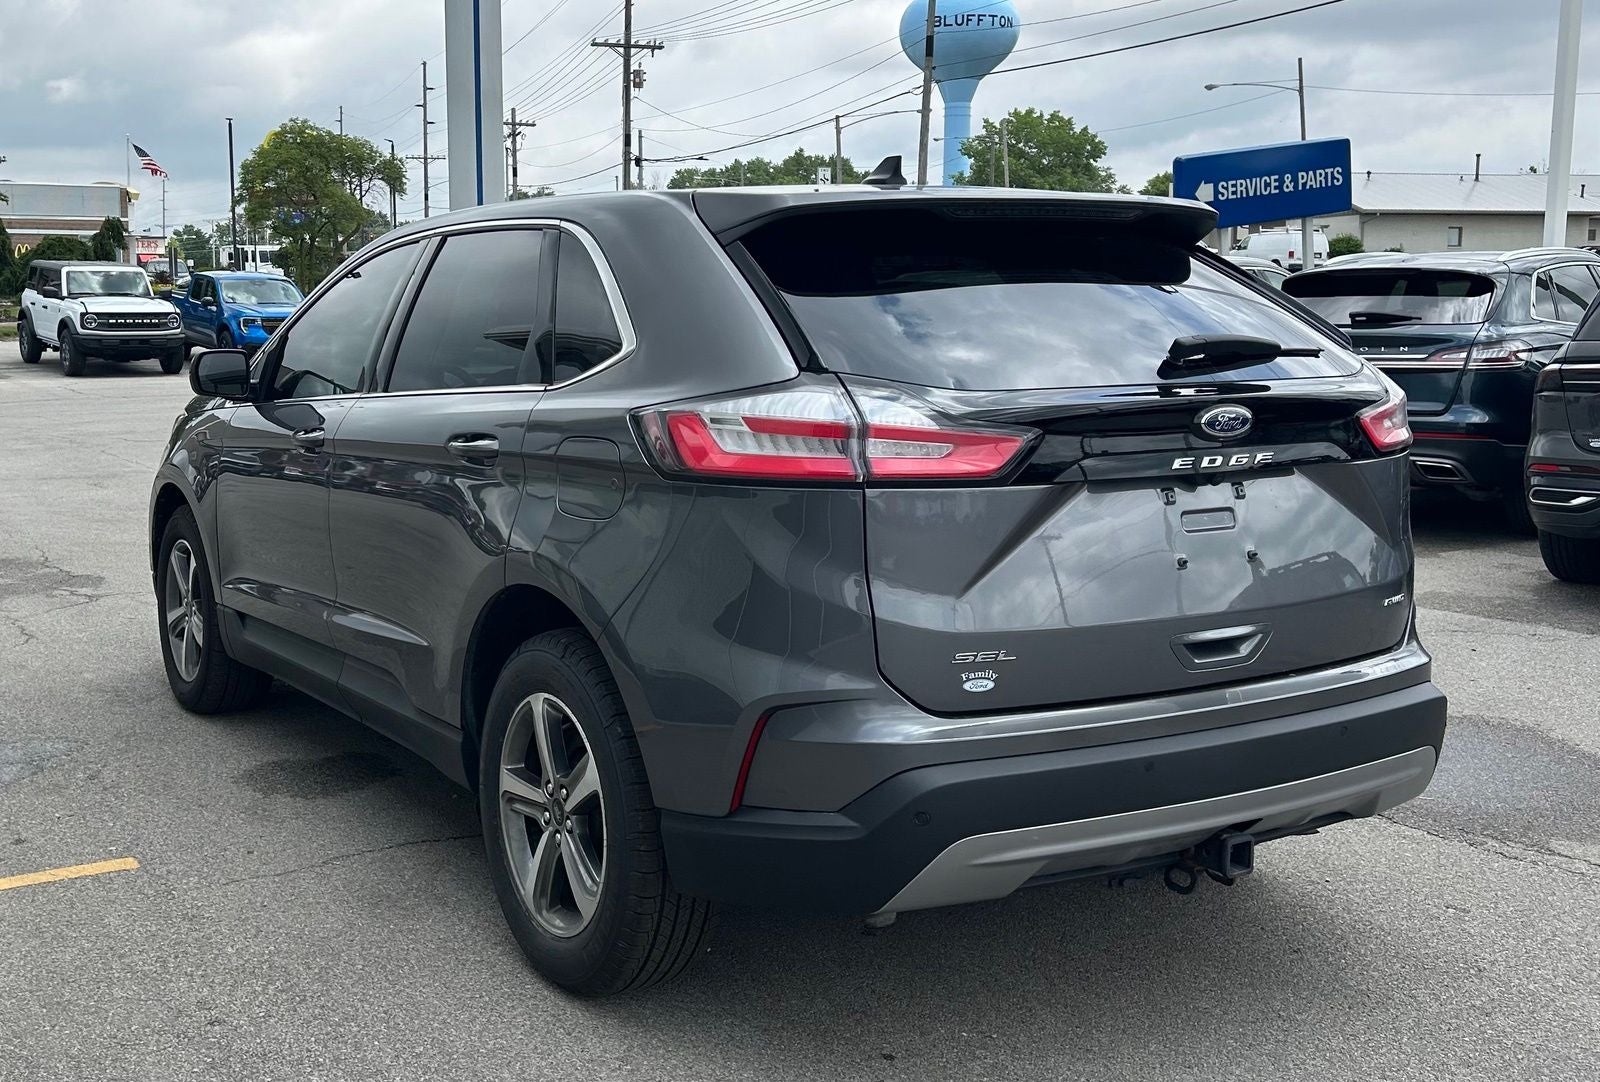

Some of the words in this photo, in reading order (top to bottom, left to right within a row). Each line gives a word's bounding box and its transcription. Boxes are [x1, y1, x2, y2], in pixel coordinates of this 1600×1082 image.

[934, 14, 1013, 28] BLUFFTON
[1218, 175, 1279, 200] SERVICE
[1283, 173, 1294, 192] &
[1298, 167, 1343, 190] PARTS
[1215, 413, 1243, 431] Ford
[1171, 452, 1275, 470] EDGE
[951, 650, 1017, 664] SEL
[961, 669, 999, 681] Family
[969, 681, 990, 690] Ford
